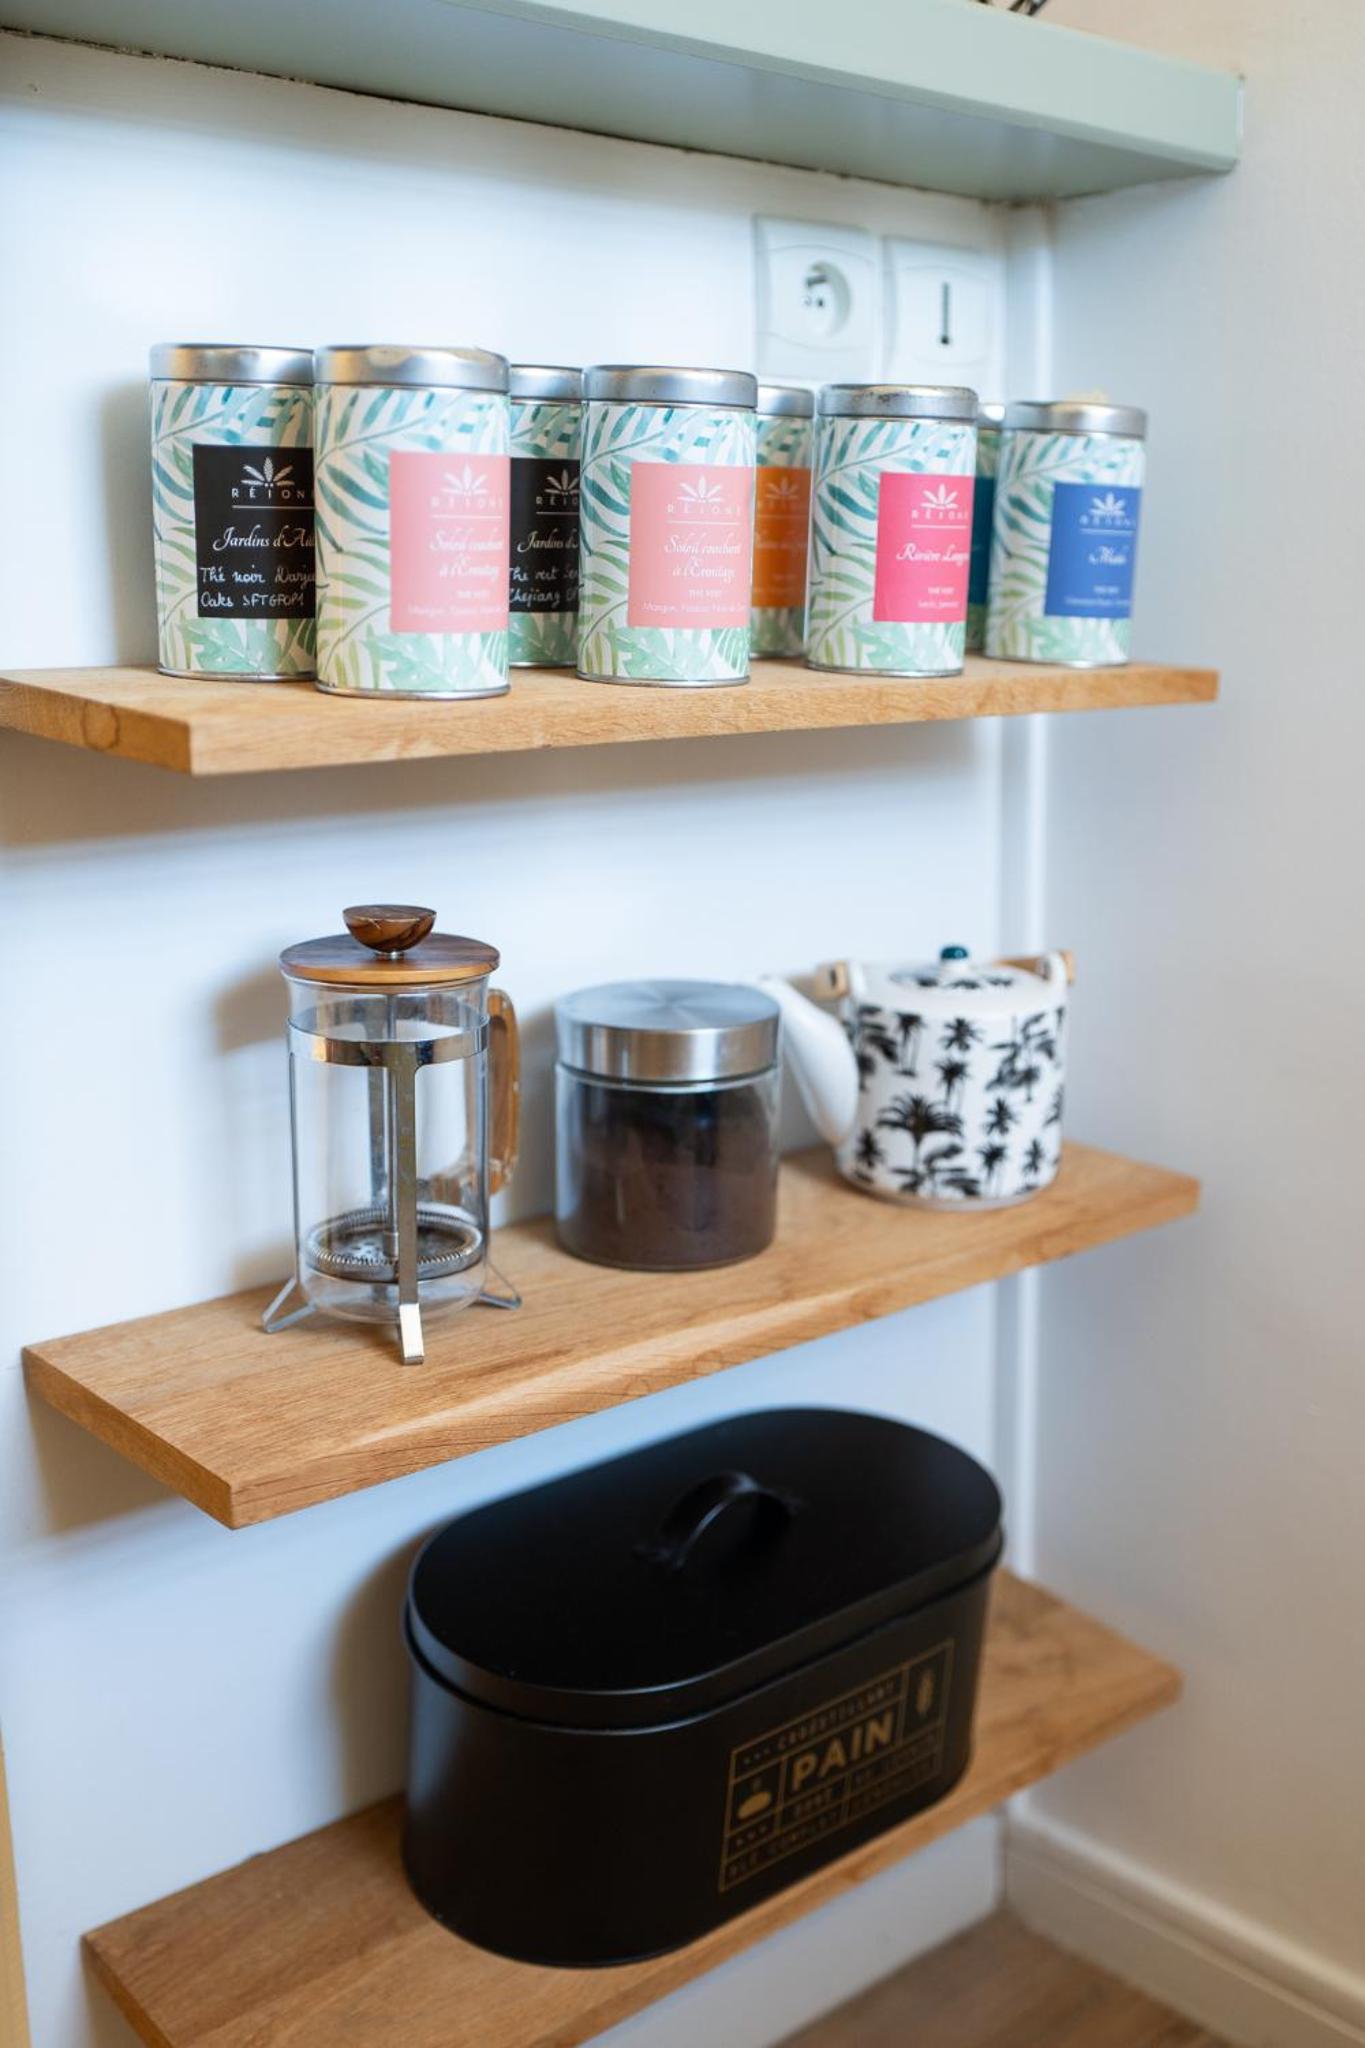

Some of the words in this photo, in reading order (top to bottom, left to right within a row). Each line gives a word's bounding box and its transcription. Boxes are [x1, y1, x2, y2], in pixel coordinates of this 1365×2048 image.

[231, 486, 306, 499] RÉION
[212, 524, 270, 551] Jardins
[517, 528, 564, 553] Jardins
[231, 563, 266, 584] noir
[790, 1710, 894, 1792] PAIN
